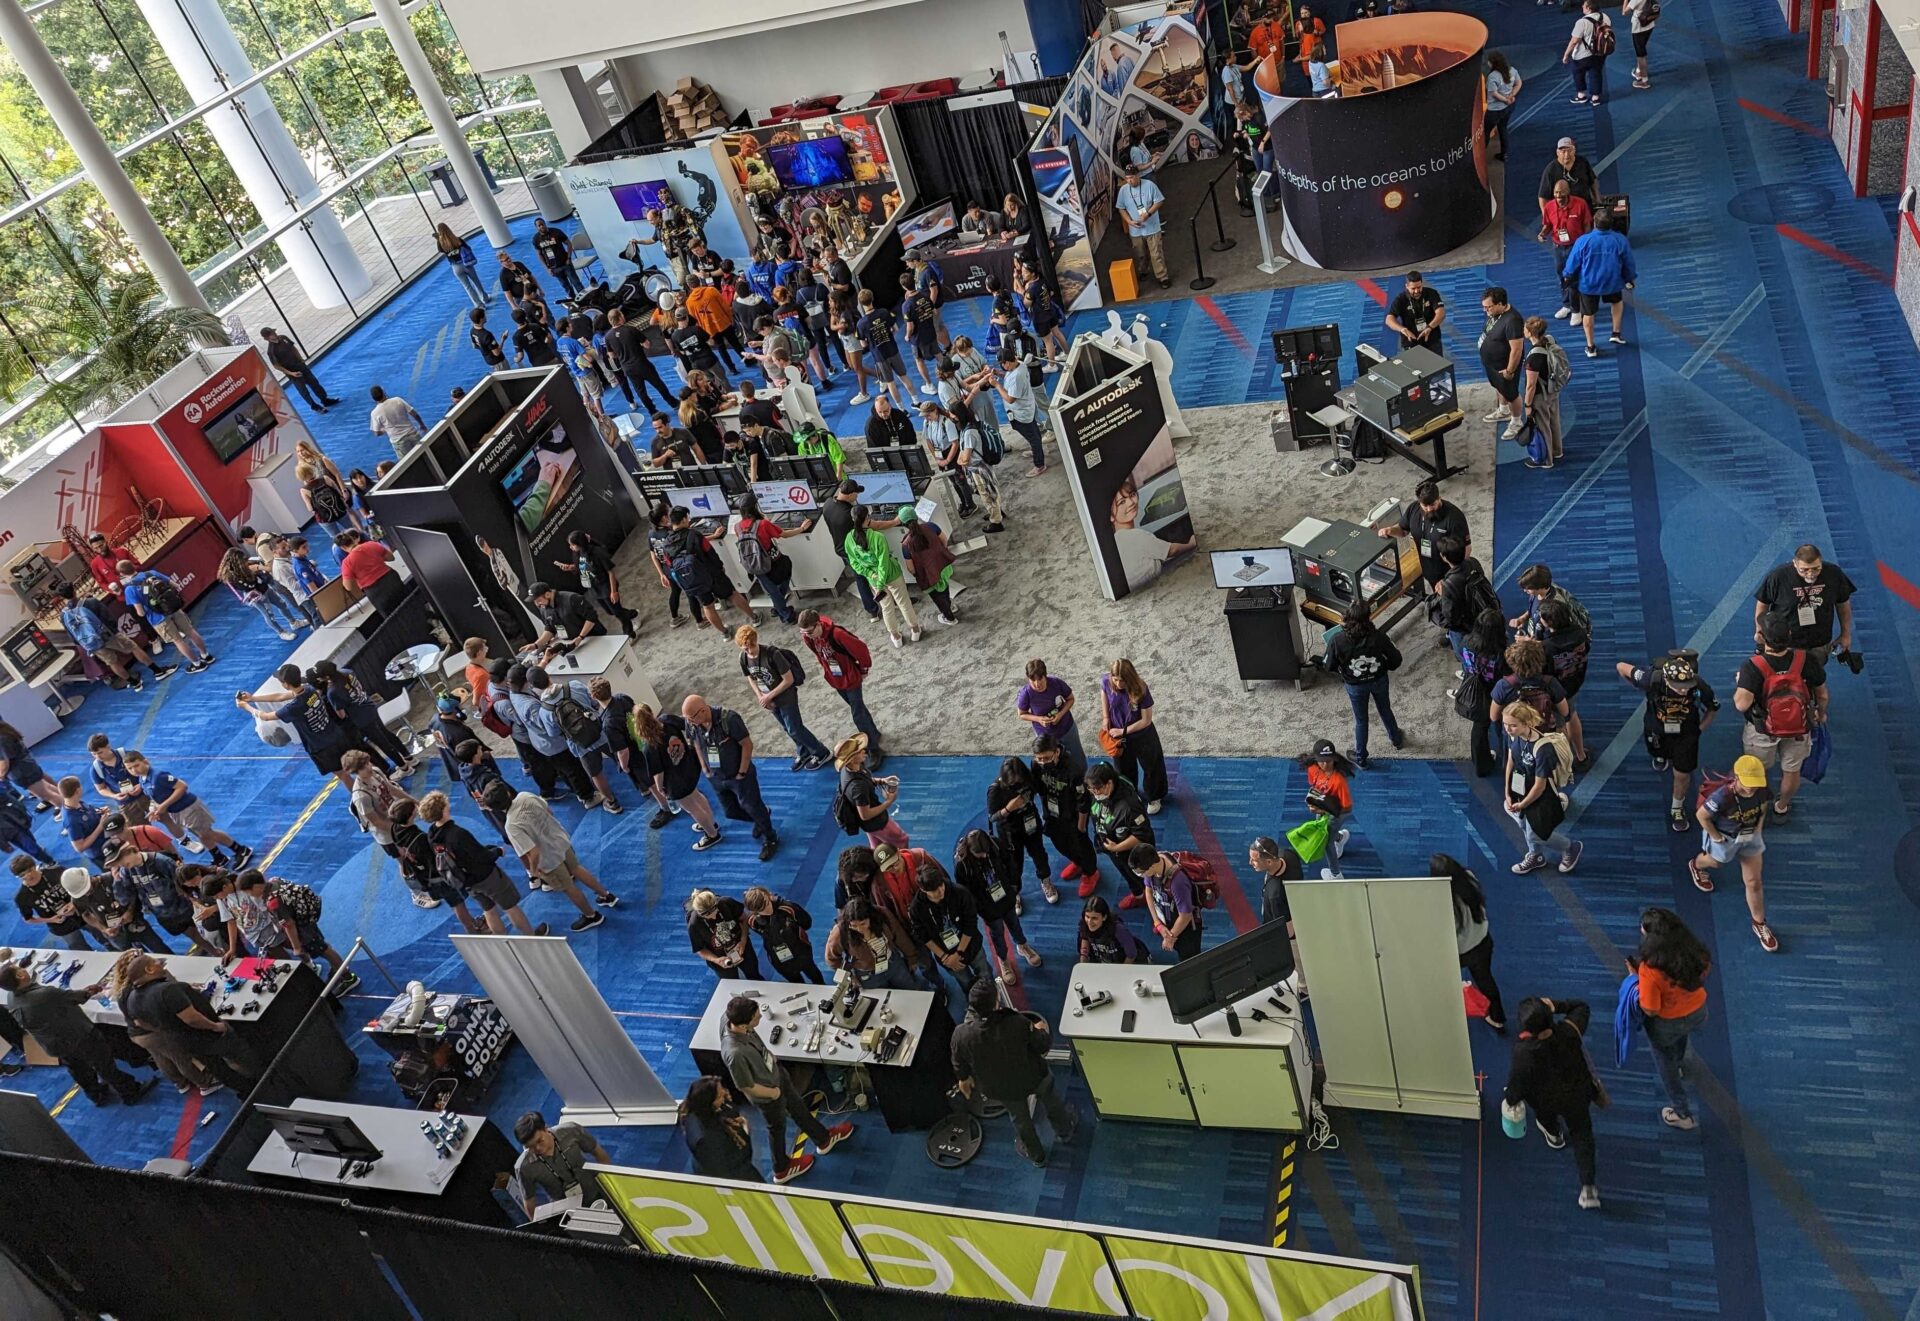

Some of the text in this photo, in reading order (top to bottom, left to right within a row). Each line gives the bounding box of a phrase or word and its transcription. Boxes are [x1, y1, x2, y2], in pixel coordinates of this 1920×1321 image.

[1287, 168, 1319, 193] depths
[1322, 175, 1337, 192] of
[1340, 174, 1367, 191] the
[1370, 163, 1427, 187] oceans
[1430, 158, 1446, 172] to
[1448, 148, 1463, 165] the
[955, 280, 982, 293] pwc
[200, 375, 234, 404] Rockwell
[205, 376, 247, 412] Automation
[1087, 376, 1143, 415] AUTODESK
[186, 407, 200, 420] RA
[1077, 422, 1095, 435] Unlock
[1095, 416, 1106, 425] free
[1106, 406, 1123, 419] access
[1080, 408, 1133, 441] educational resources
[1089, 423, 1117, 442] classrooms
[1117, 417, 1127, 426] and
[1127, 409, 1143, 420] teams
[484, 430, 516, 466] AUTODESK
[488, 443, 517, 475] Make Anything
[529, 529, 545, 549] Prepare
[544, 510, 561, 531] students
[566, 496, 574, 505] the
[571, 483, 584, 498] future
[534, 494, 584, 556] of design and manufacturing
[456, 1003, 487, 1054] OINK
[465, 1013, 495, 1066] OINK
[472, 1016, 508, 1078] BOOM
[938, 1144, 962, 1153] CAP
